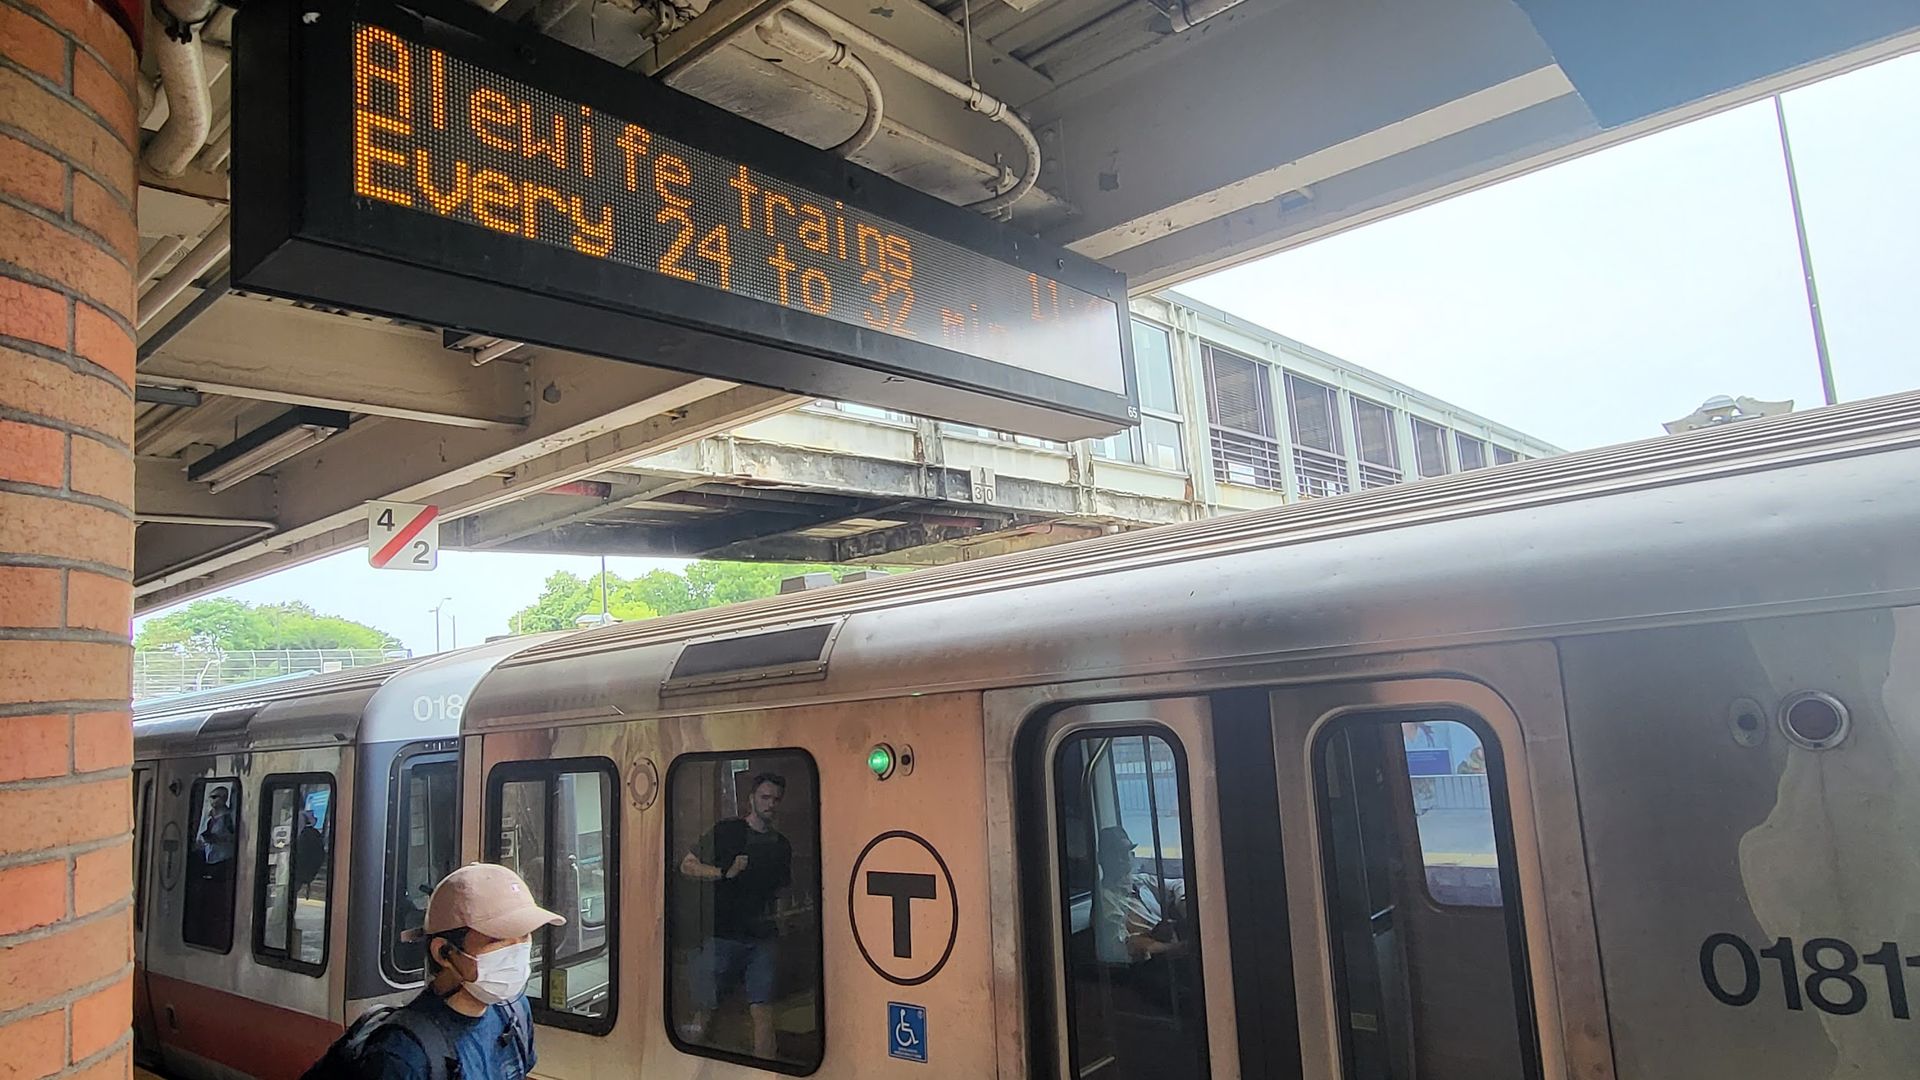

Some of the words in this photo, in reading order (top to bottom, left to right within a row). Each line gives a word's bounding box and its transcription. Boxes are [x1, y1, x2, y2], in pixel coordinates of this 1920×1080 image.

[355, 27, 693, 207] Alewife
[729, 163, 914, 281] trains
[354, 110, 613, 257] Every
[656, 206, 732, 290] 24
[768, 242, 831, 316] to
[861, 271, 918, 336] 32
[1127, 405, 1138, 419] 65
[377, 508, 395, 531] 4
[413, 541, 430, 564] 2
[413, 694, 464, 721] 018
[867, 871, 936, 959] T
[1700, 932, 1920, 1020] 0181
